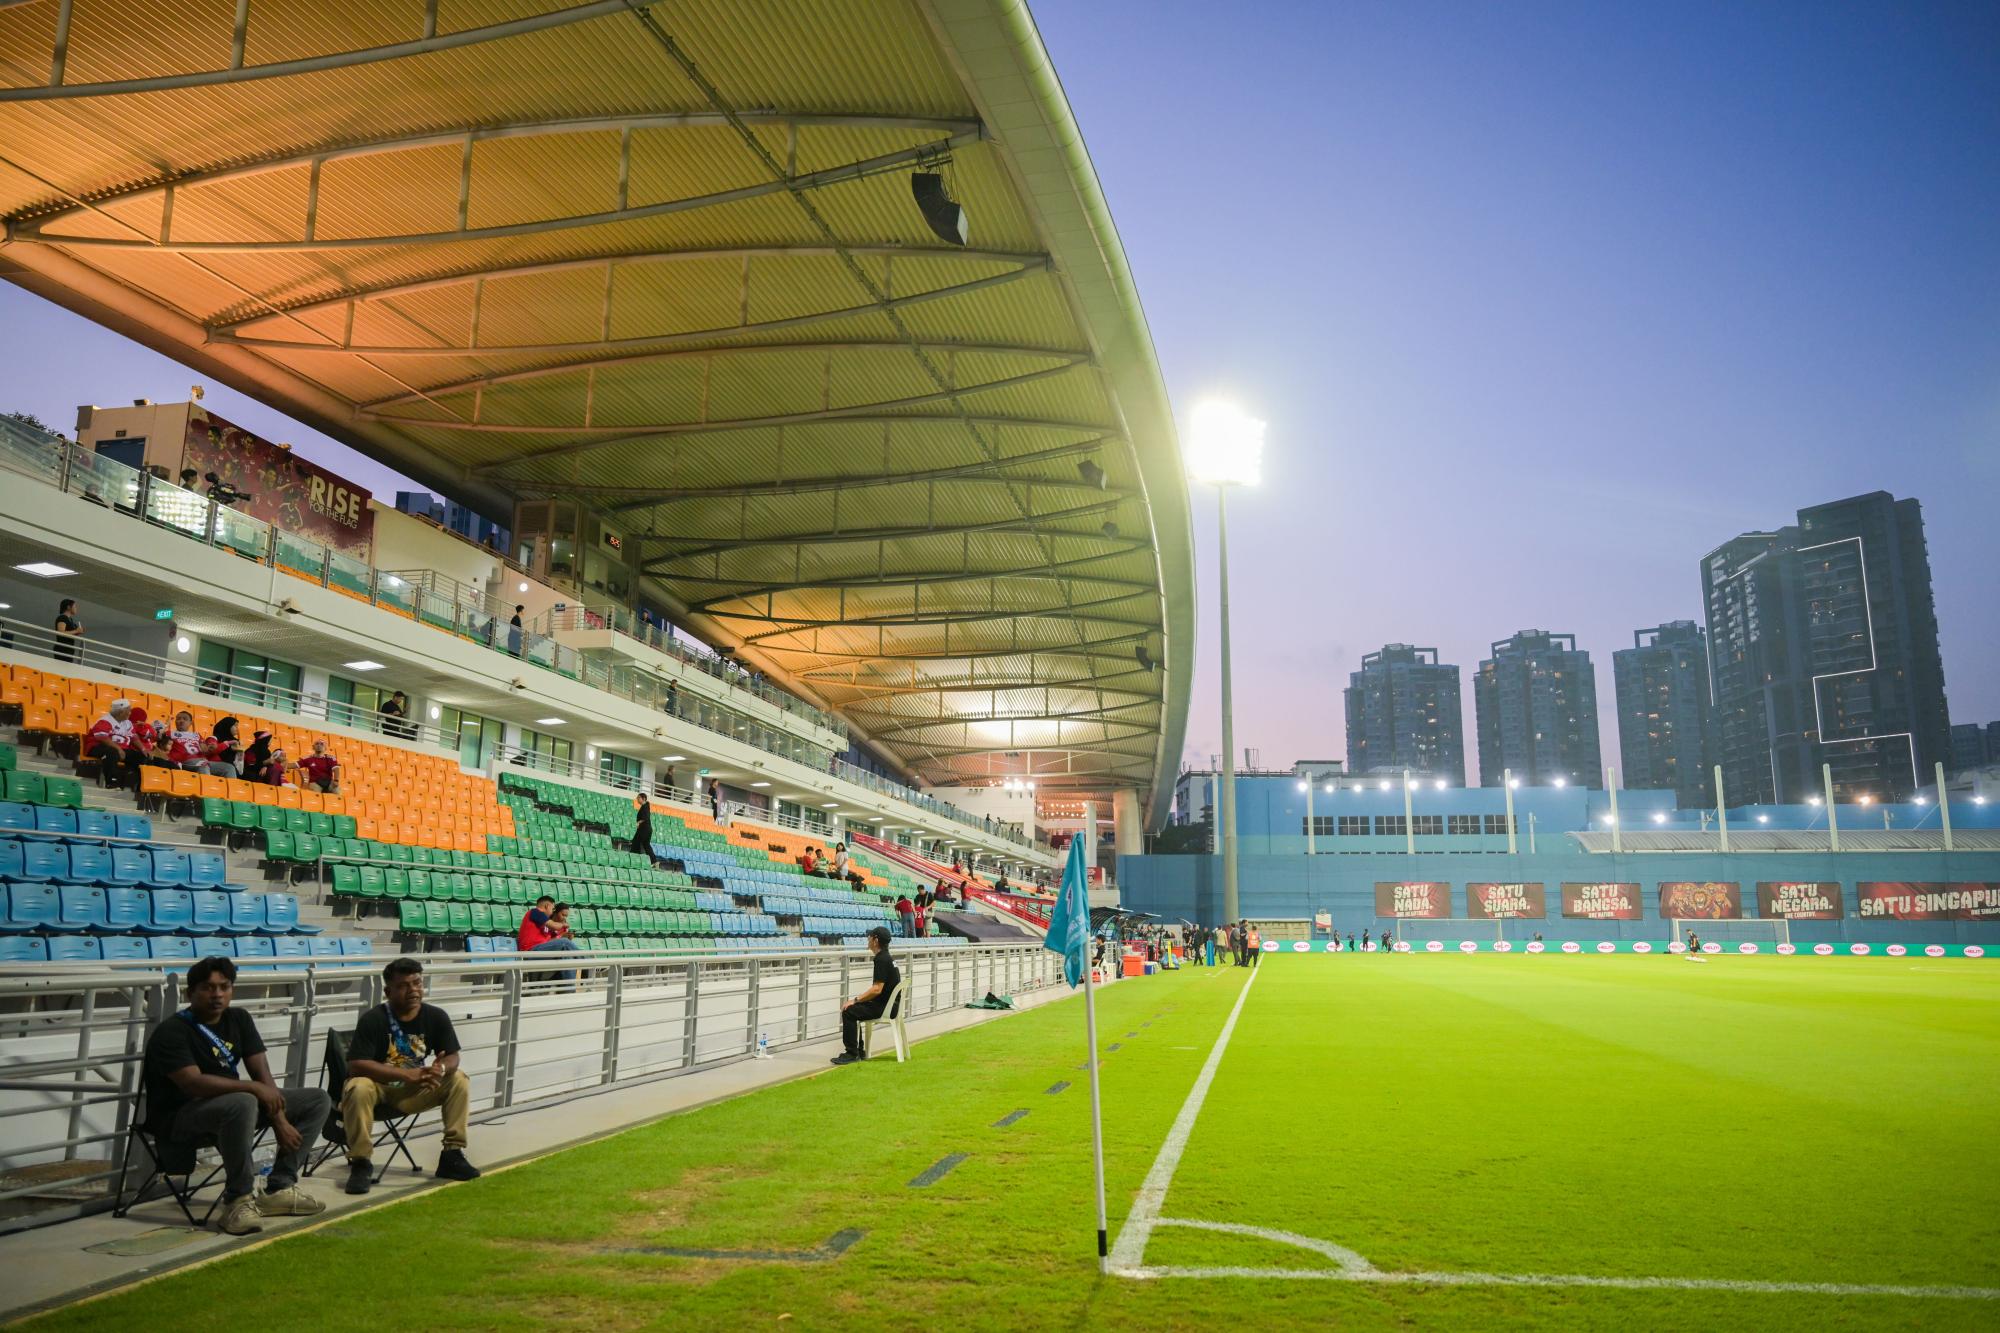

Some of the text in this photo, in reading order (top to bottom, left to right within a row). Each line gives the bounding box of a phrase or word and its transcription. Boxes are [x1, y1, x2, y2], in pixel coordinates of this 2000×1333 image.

[310, 474, 360, 520] RISE
[310, 502, 358, 529] FOR THE FLAG
[1394, 884, 1428, 898] SATU
[1488, 884, 1523, 899] SATU
[1582, 884, 1618, 899] SATU
[1780, 884, 1818, 899] SATU
[1394, 897, 1433, 912] NADA.
[1484, 897, 1531, 913] SUARA.
[1574, 897, 1632, 912] BANGSA.
[1771, 896, 1833, 913] NEGARA.
[1860, 896, 1911, 916] SATU
